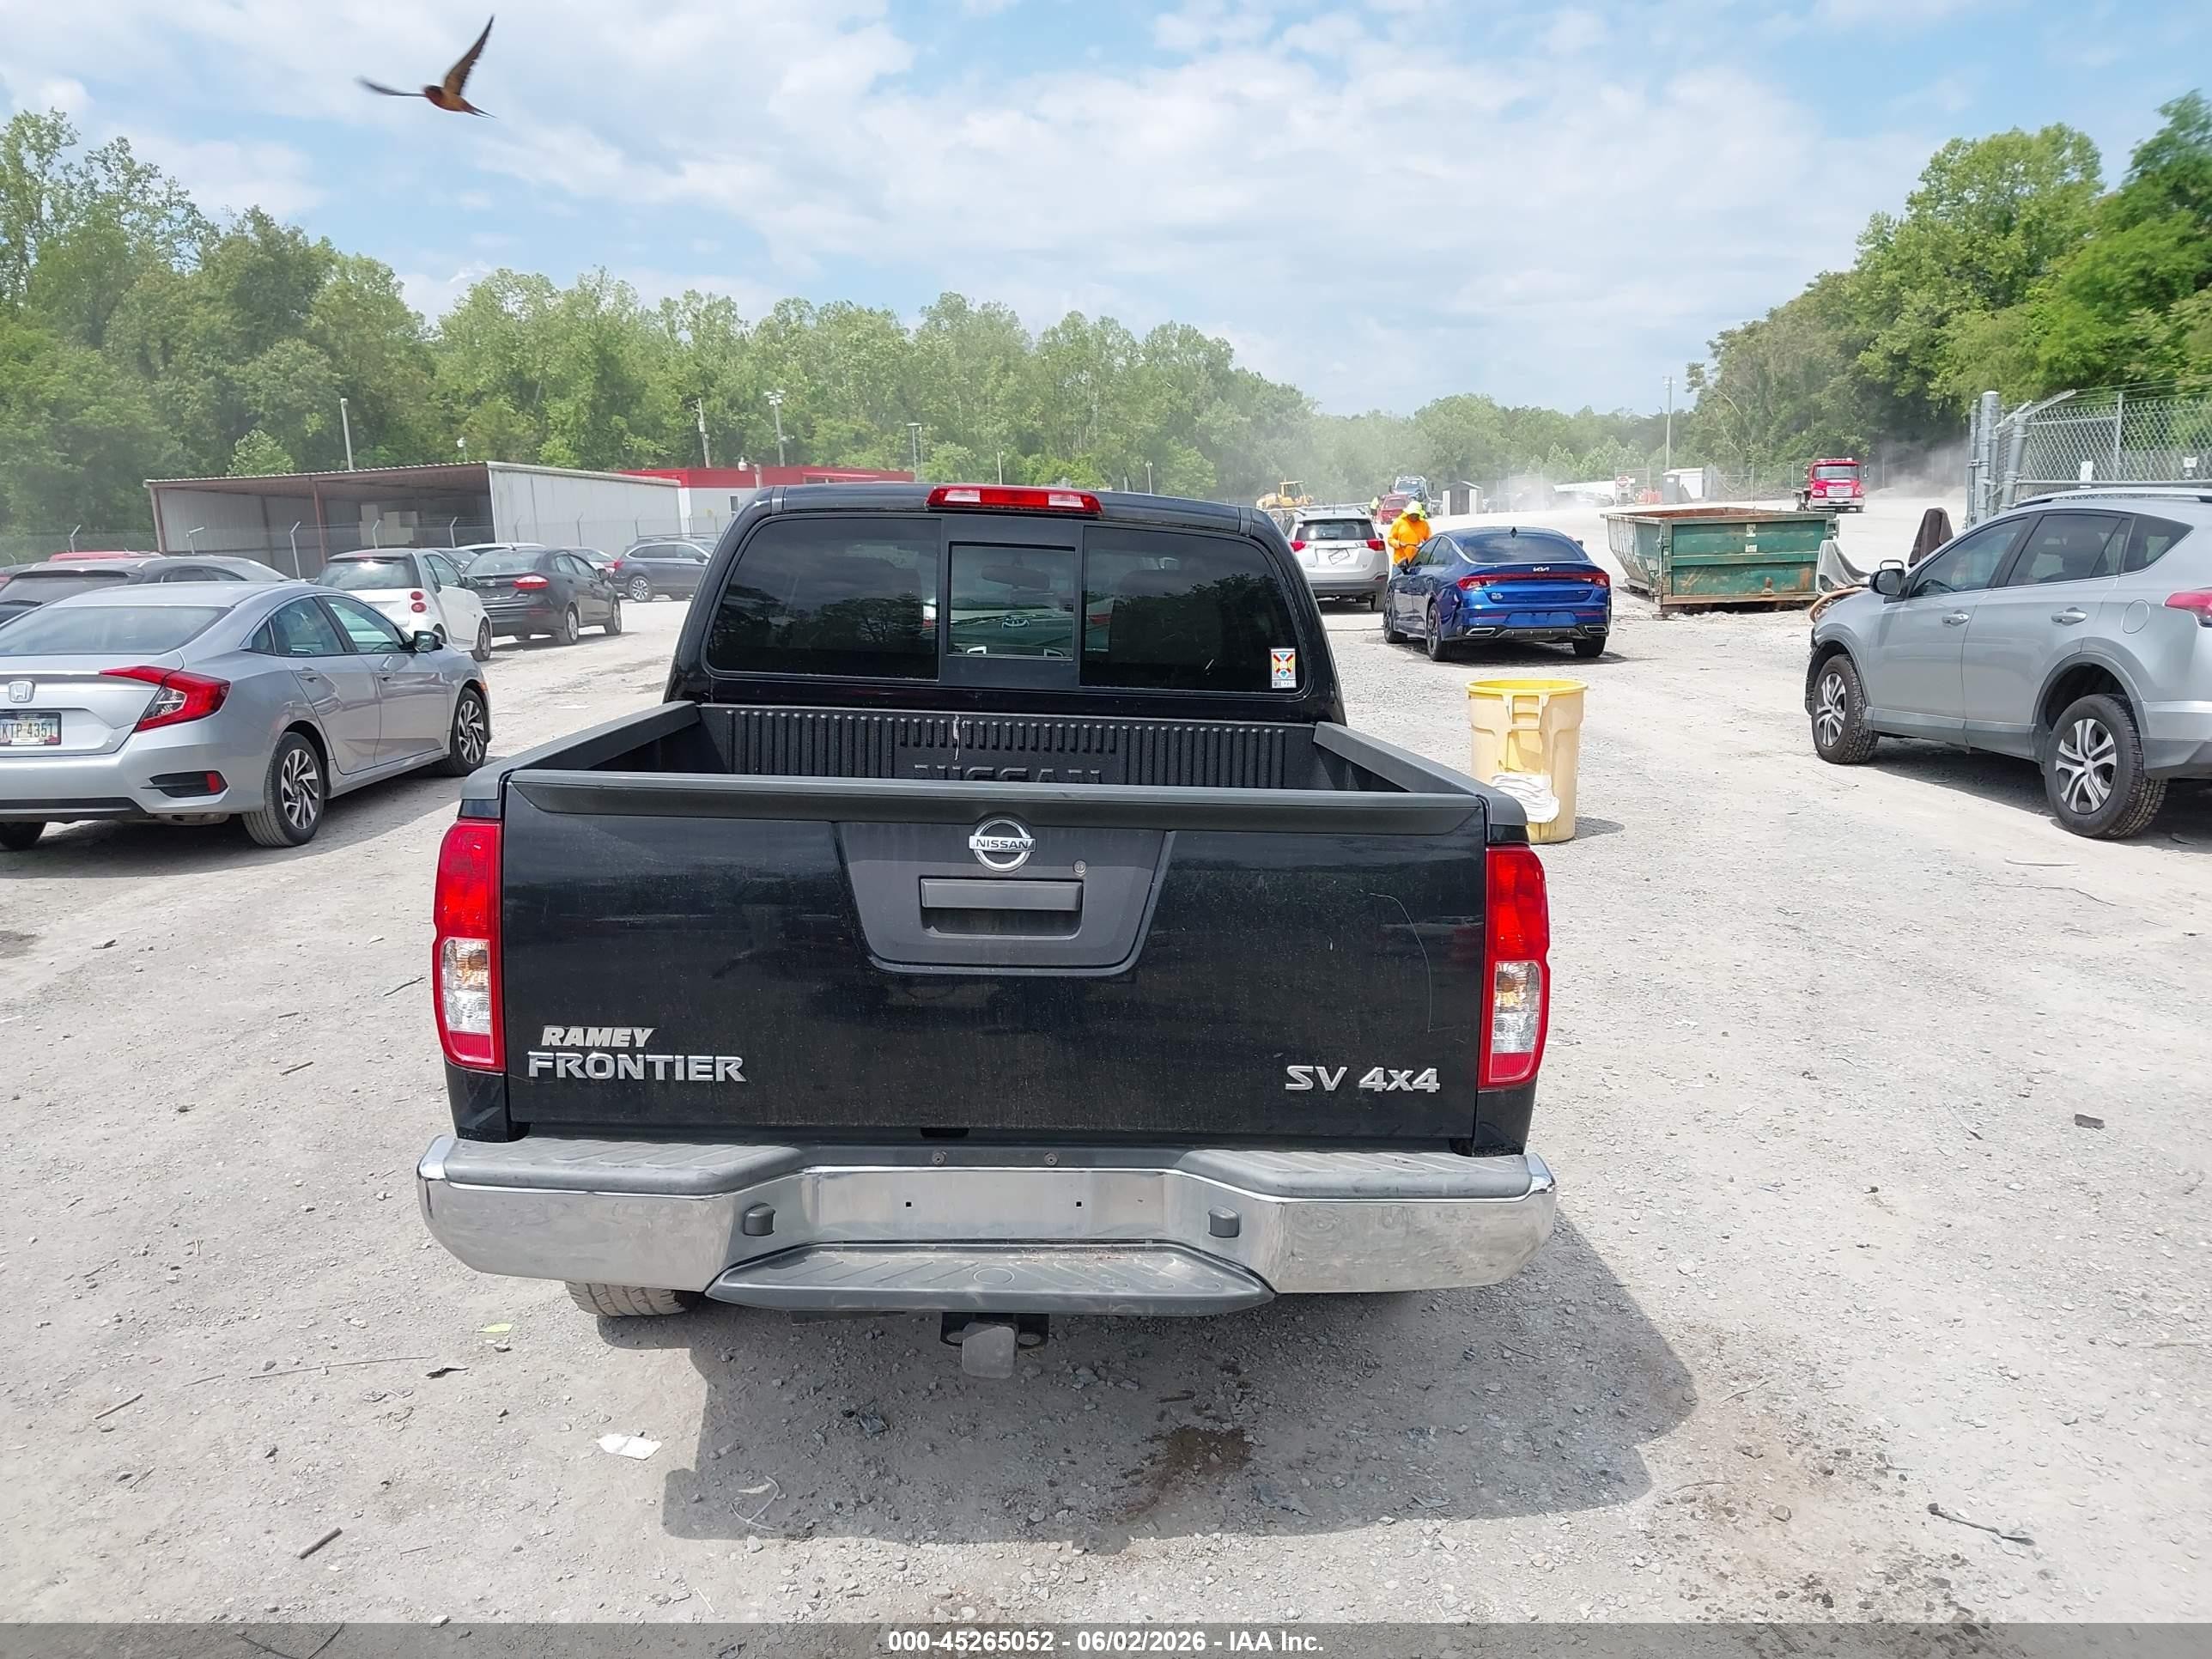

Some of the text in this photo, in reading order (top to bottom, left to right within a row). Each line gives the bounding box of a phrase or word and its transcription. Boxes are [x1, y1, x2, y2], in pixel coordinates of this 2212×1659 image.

[975, 838, 1030, 850] NISSAN
[541, 1025, 657, 1048] RAMEY
[527, 1051, 746, 1082] FRONTIER
[1285, 1065, 1441, 1093] SV 4x4
